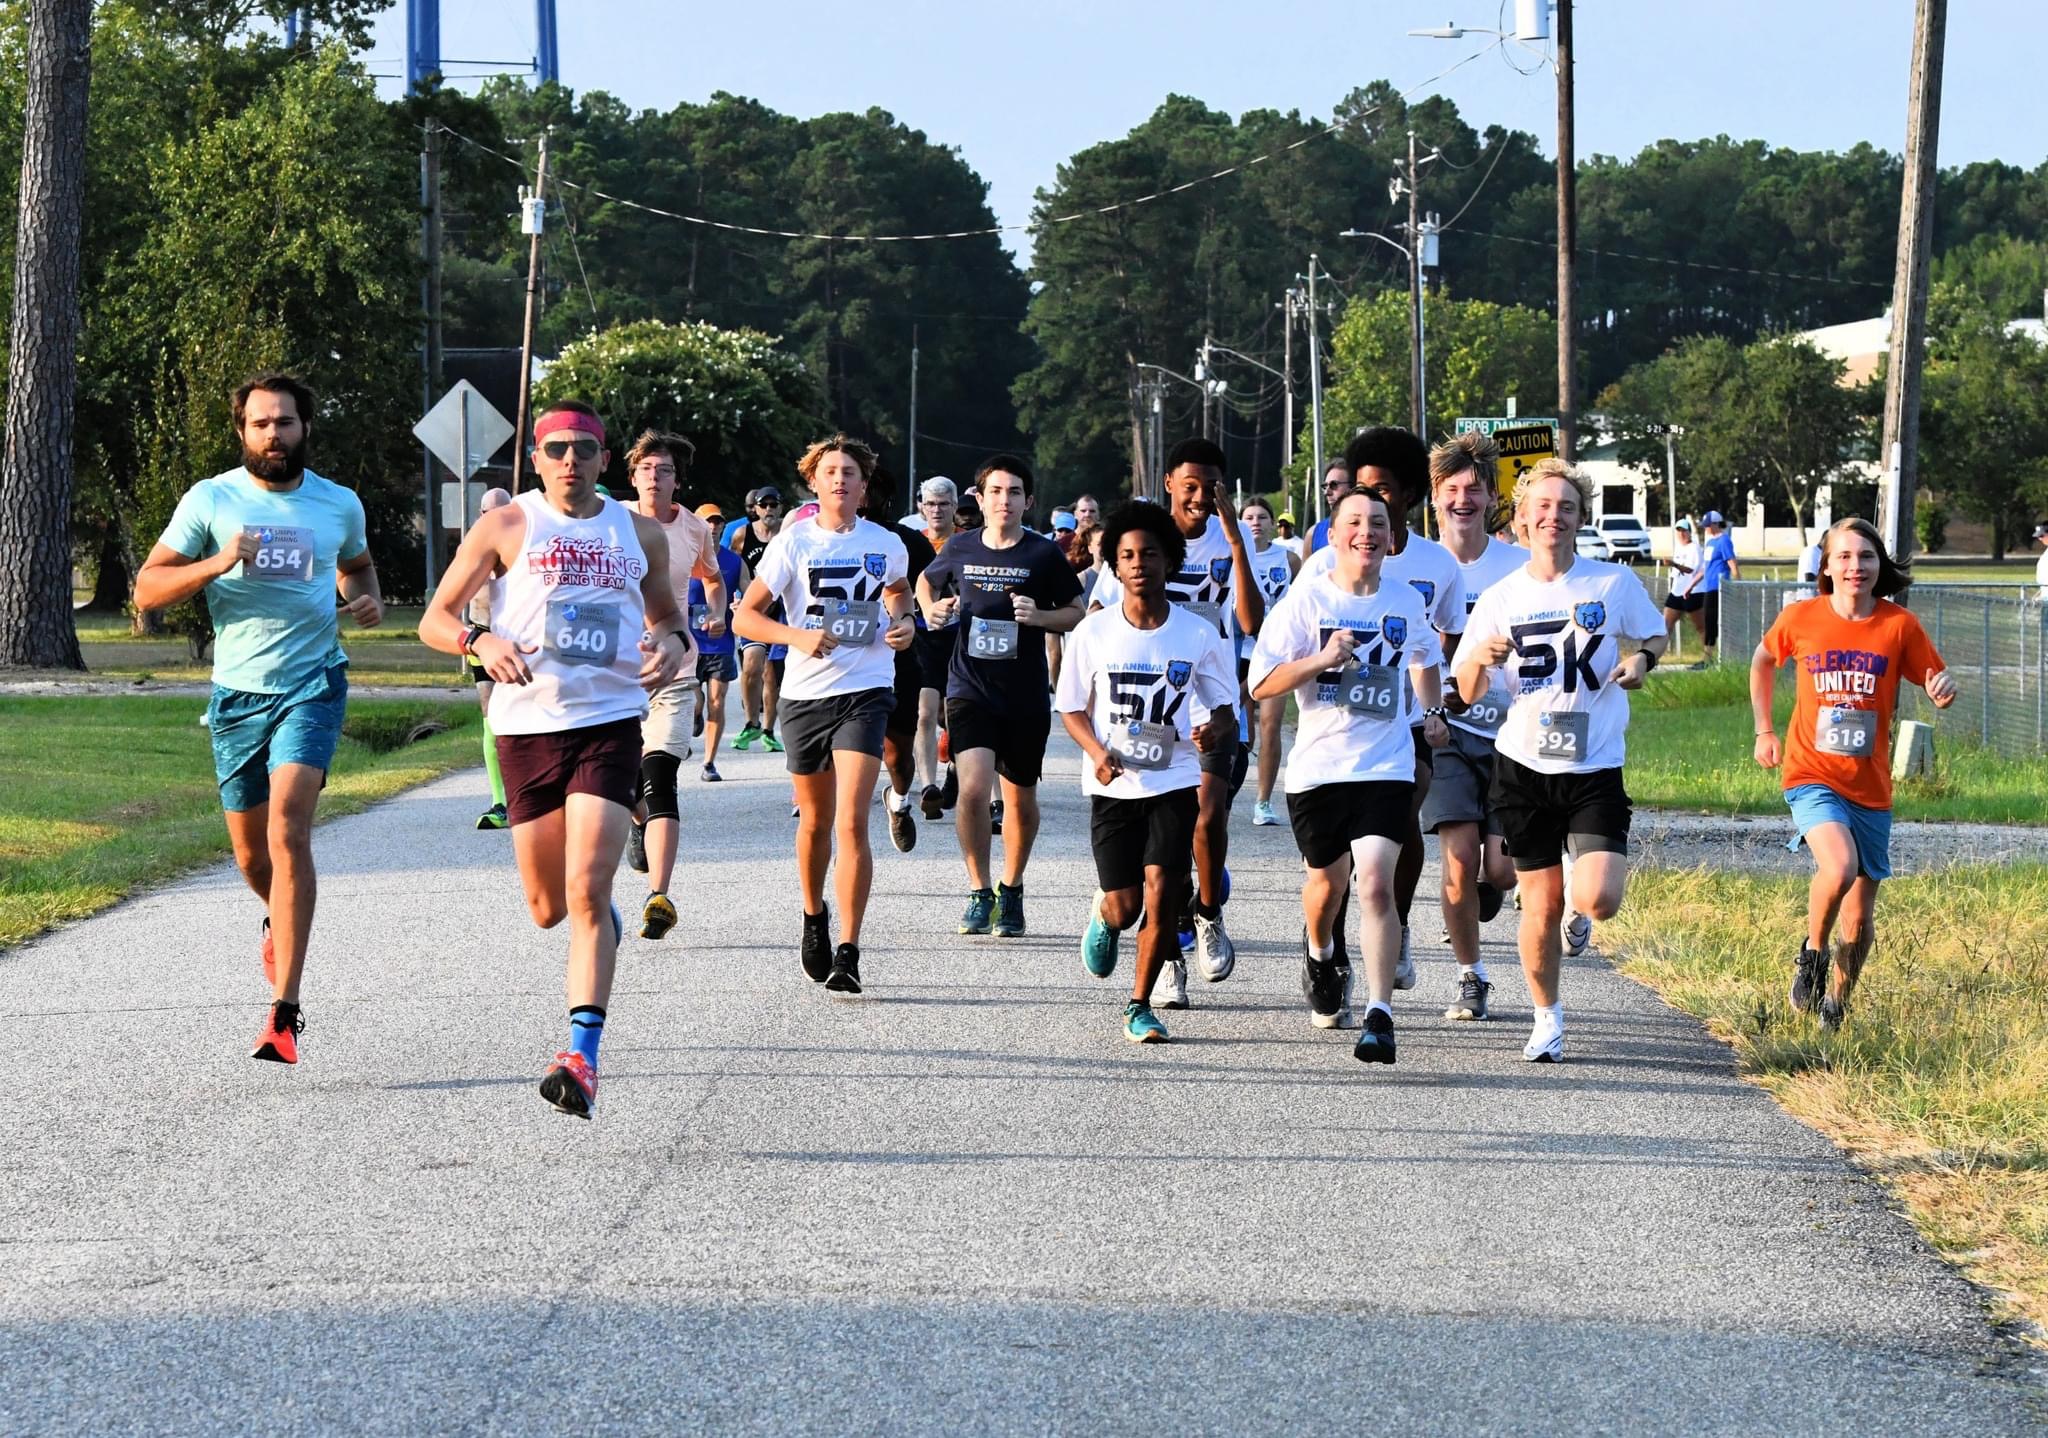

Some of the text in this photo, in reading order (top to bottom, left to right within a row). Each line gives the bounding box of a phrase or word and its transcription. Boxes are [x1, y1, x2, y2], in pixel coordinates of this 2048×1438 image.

[1499, 432, 1550, 452] CAUTION
[255, 548, 302, 569] 654
[528, 551, 642, 579] RUNNING
[1184, 564, 1207, 572] NUAL
[963, 565, 1031, 577] BRUINS
[544, 573, 626, 590] RACING TEAM
[832, 619, 869, 637] 617
[1339, 619, 1380, 629] ANNUAL
[556, 626, 607, 652] 640
[975, 635, 1009, 652] 615
[1510, 618, 1606, 694] 5K
[1804, 649, 1889, 678] CLEMSON
[1122, 662, 1163, 672] ANNUAL
[1318, 685, 1338, 693] BAC
[1813, 670, 1877, 695] UNITED
[1349, 684, 1392, 708] 616
[1107, 671, 1187, 742] 5K
[1458, 704, 1498, 723] 90
[1825, 727, 1866, 748] 618
[1121, 739, 1163, 762] 650
